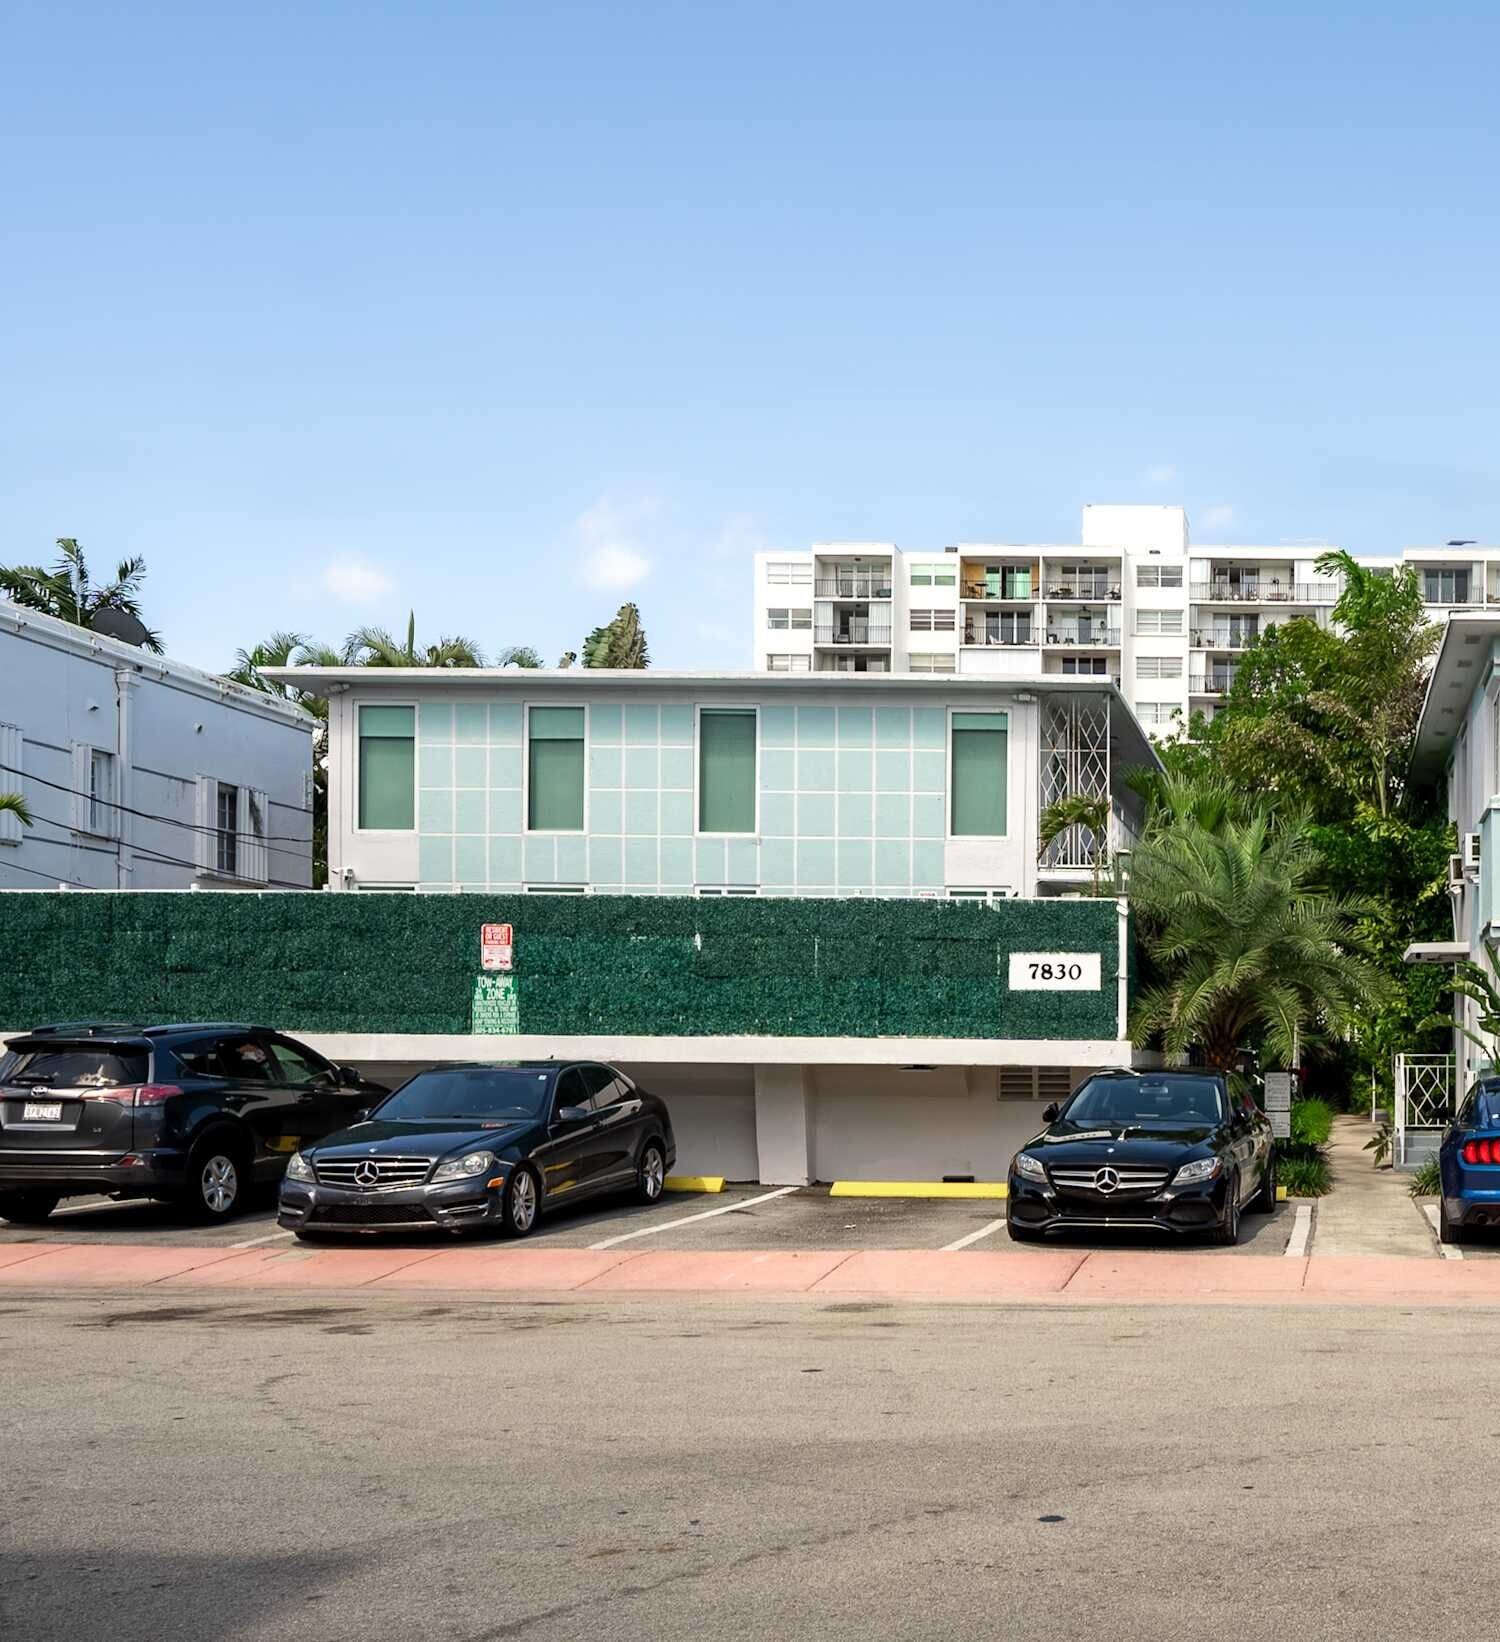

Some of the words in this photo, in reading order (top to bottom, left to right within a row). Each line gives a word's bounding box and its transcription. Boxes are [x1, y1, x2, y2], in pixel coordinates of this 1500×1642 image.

[1029, 963, 1082, 980] 7830
[476, 975, 513, 988] TOW-AWAY
[486, 988, 506, 1000] ZONE
